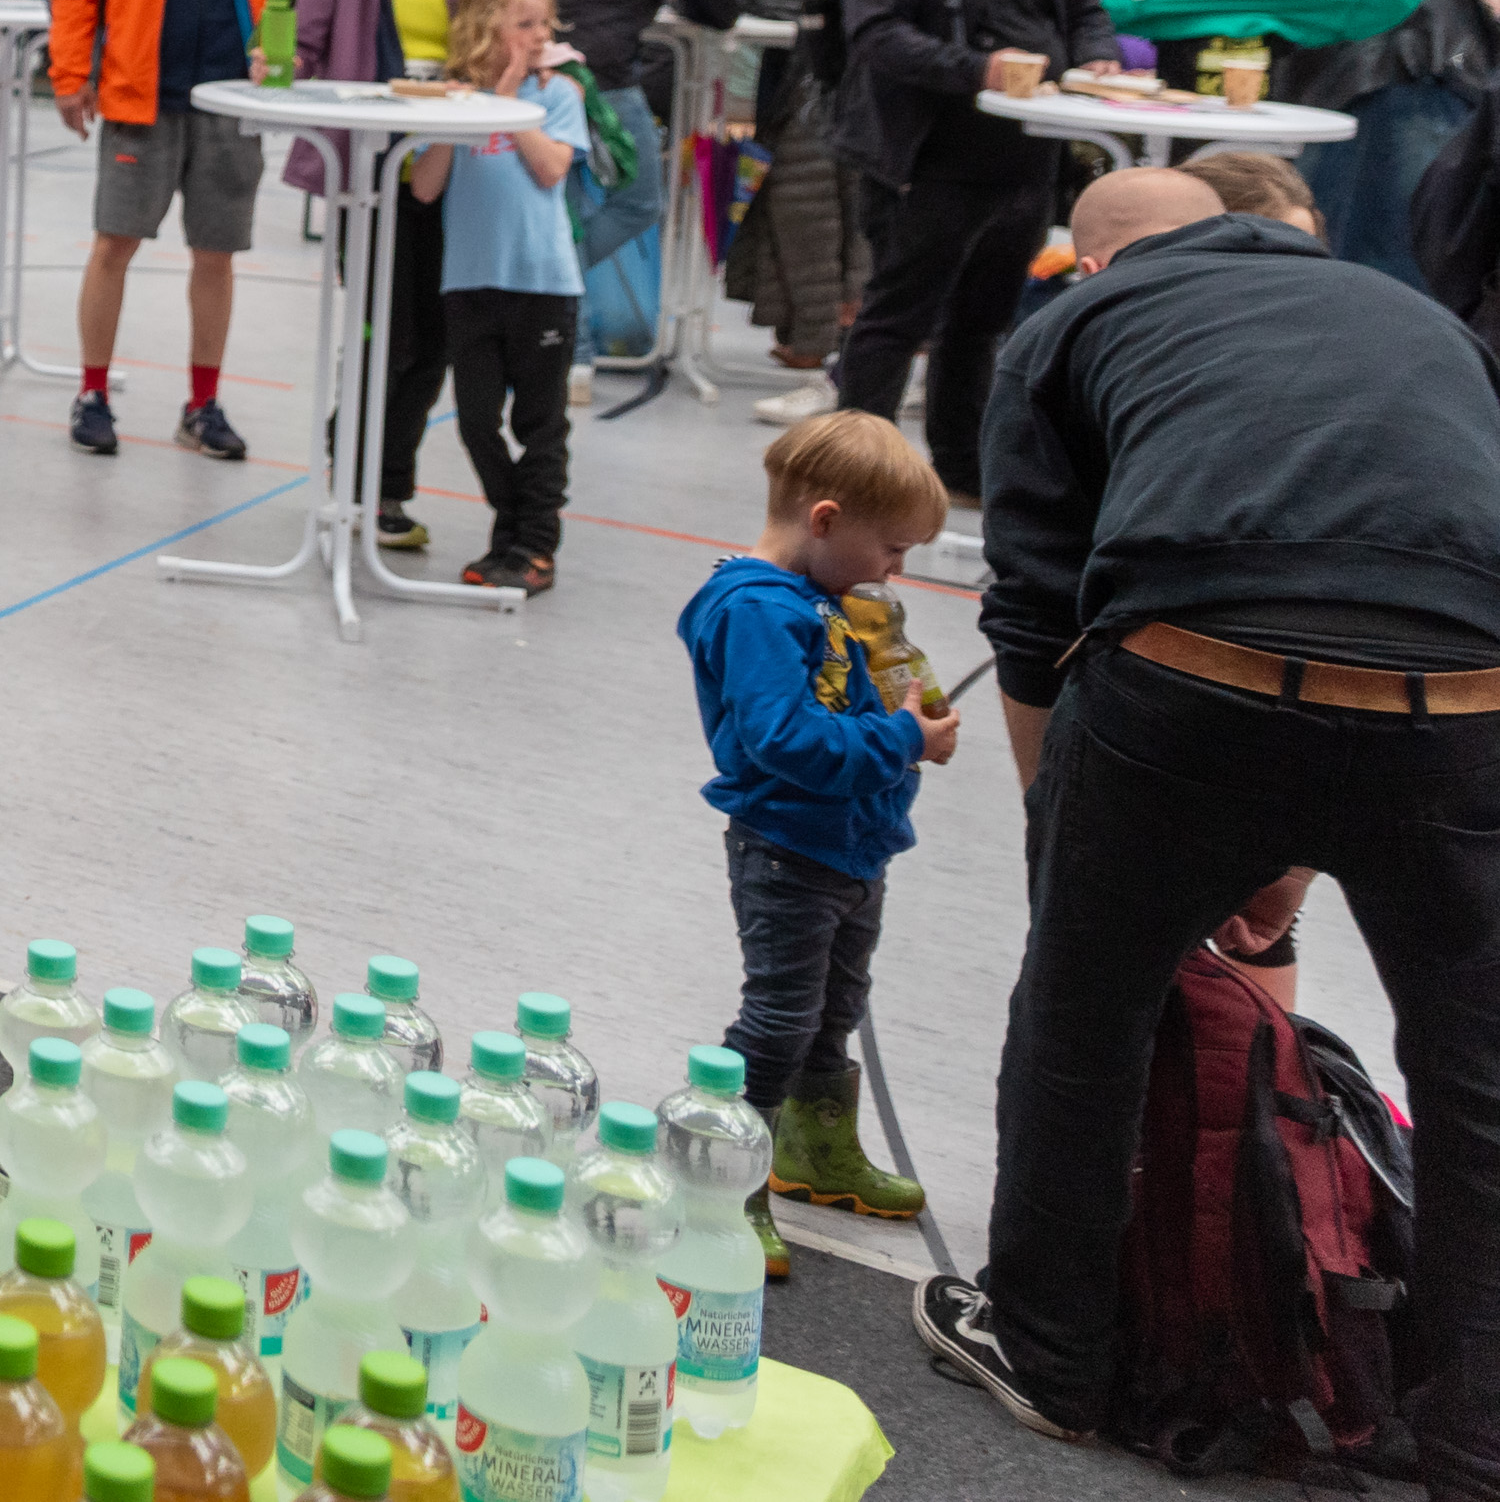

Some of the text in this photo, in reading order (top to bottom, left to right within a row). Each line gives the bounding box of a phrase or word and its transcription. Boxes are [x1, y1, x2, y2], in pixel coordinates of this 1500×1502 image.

[700, 1308, 751, 1321] Natürliches
[686, 1317, 756, 1337] MINERAL
[696, 1336, 750, 1351] WASSER
[481, 1451, 566, 1484] MINERAL
[491, 1475, 554, 1499] WASSER
